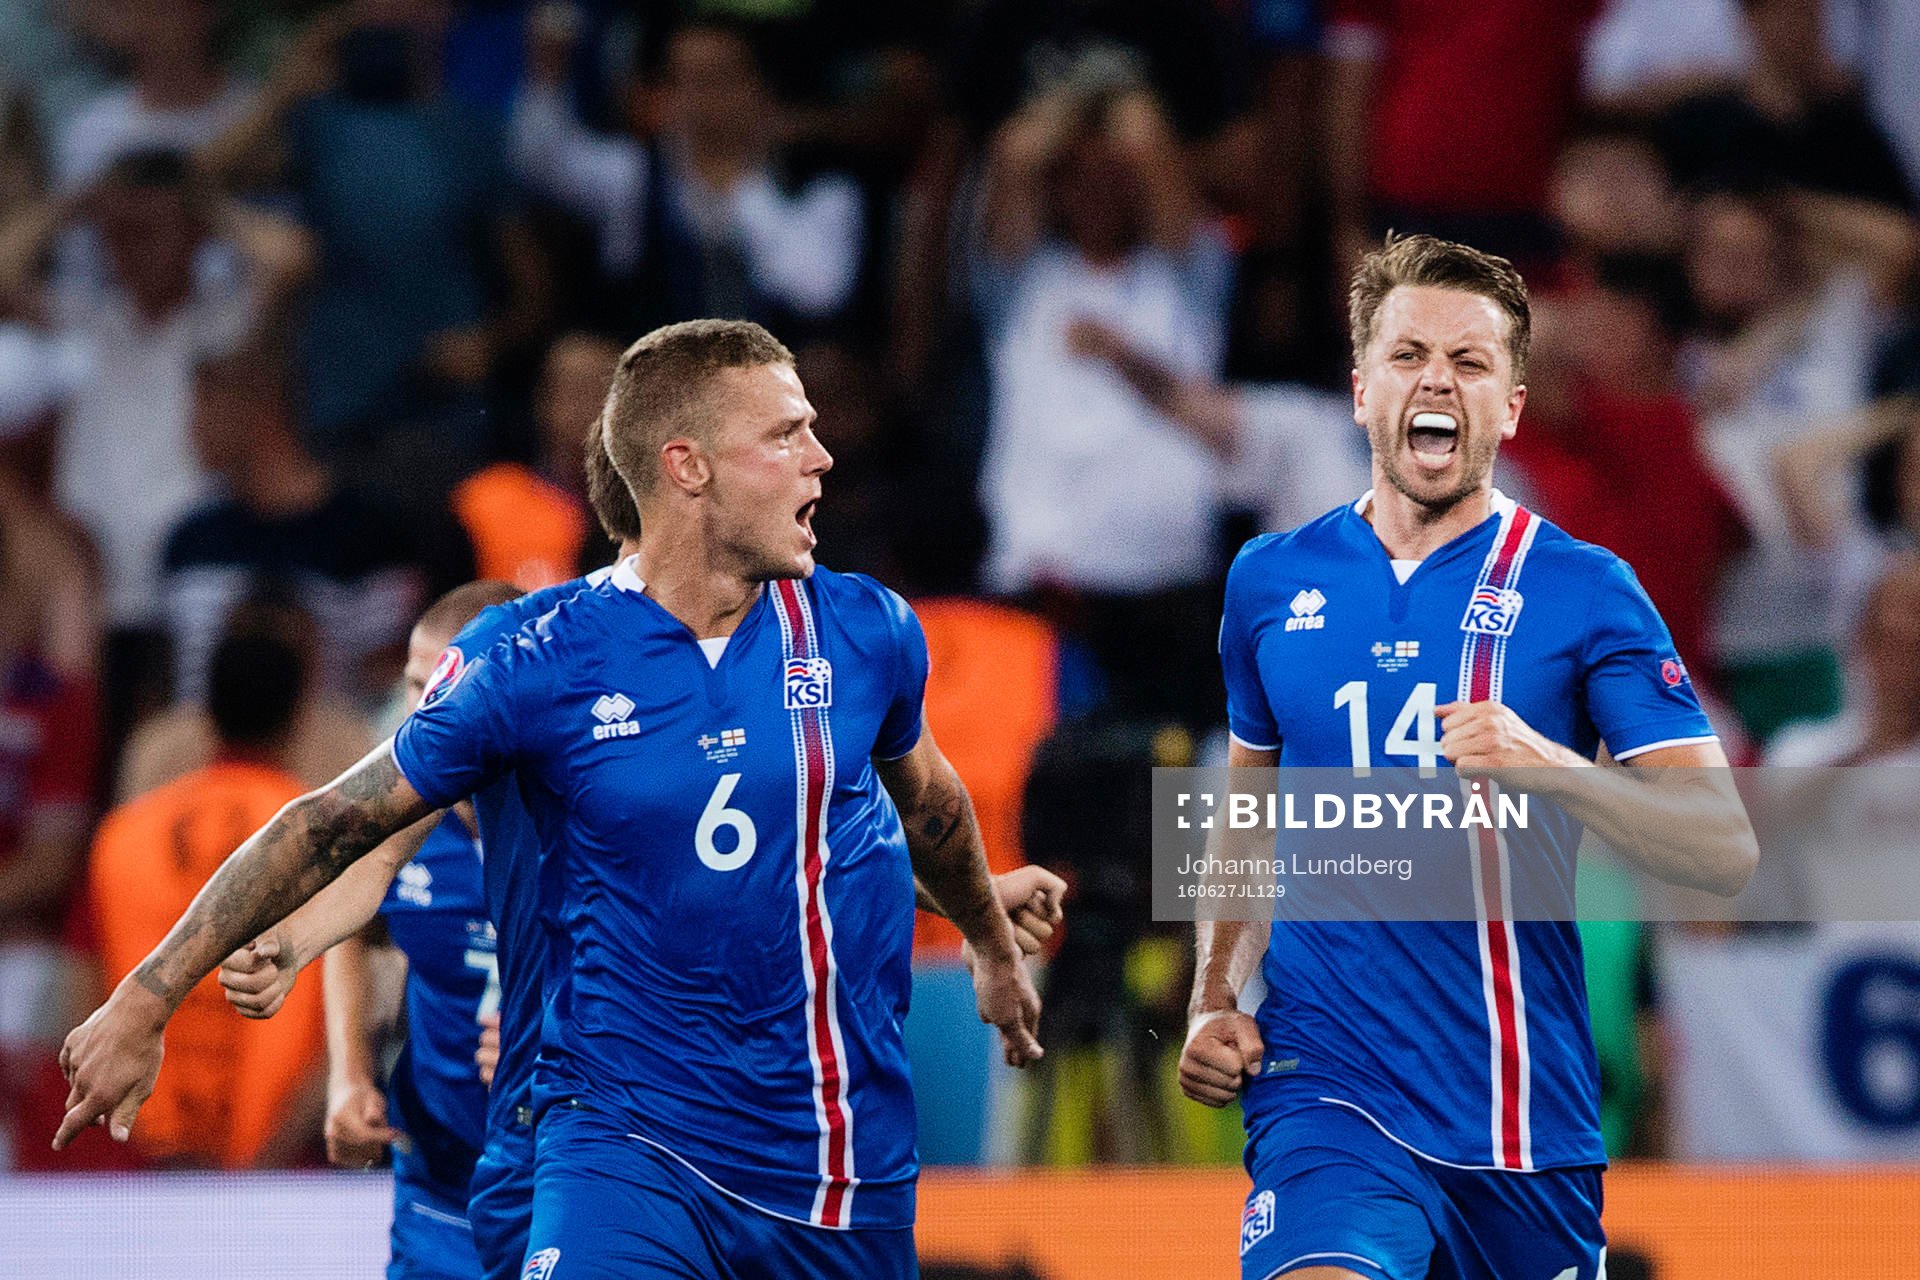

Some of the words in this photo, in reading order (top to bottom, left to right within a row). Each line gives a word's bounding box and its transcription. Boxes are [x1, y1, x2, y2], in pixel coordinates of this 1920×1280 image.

[593, 720, 641, 740] errea
[1333, 681, 1445, 778] 14
[694, 772, 757, 872] 6
[463, 949, 502, 1027] 7
